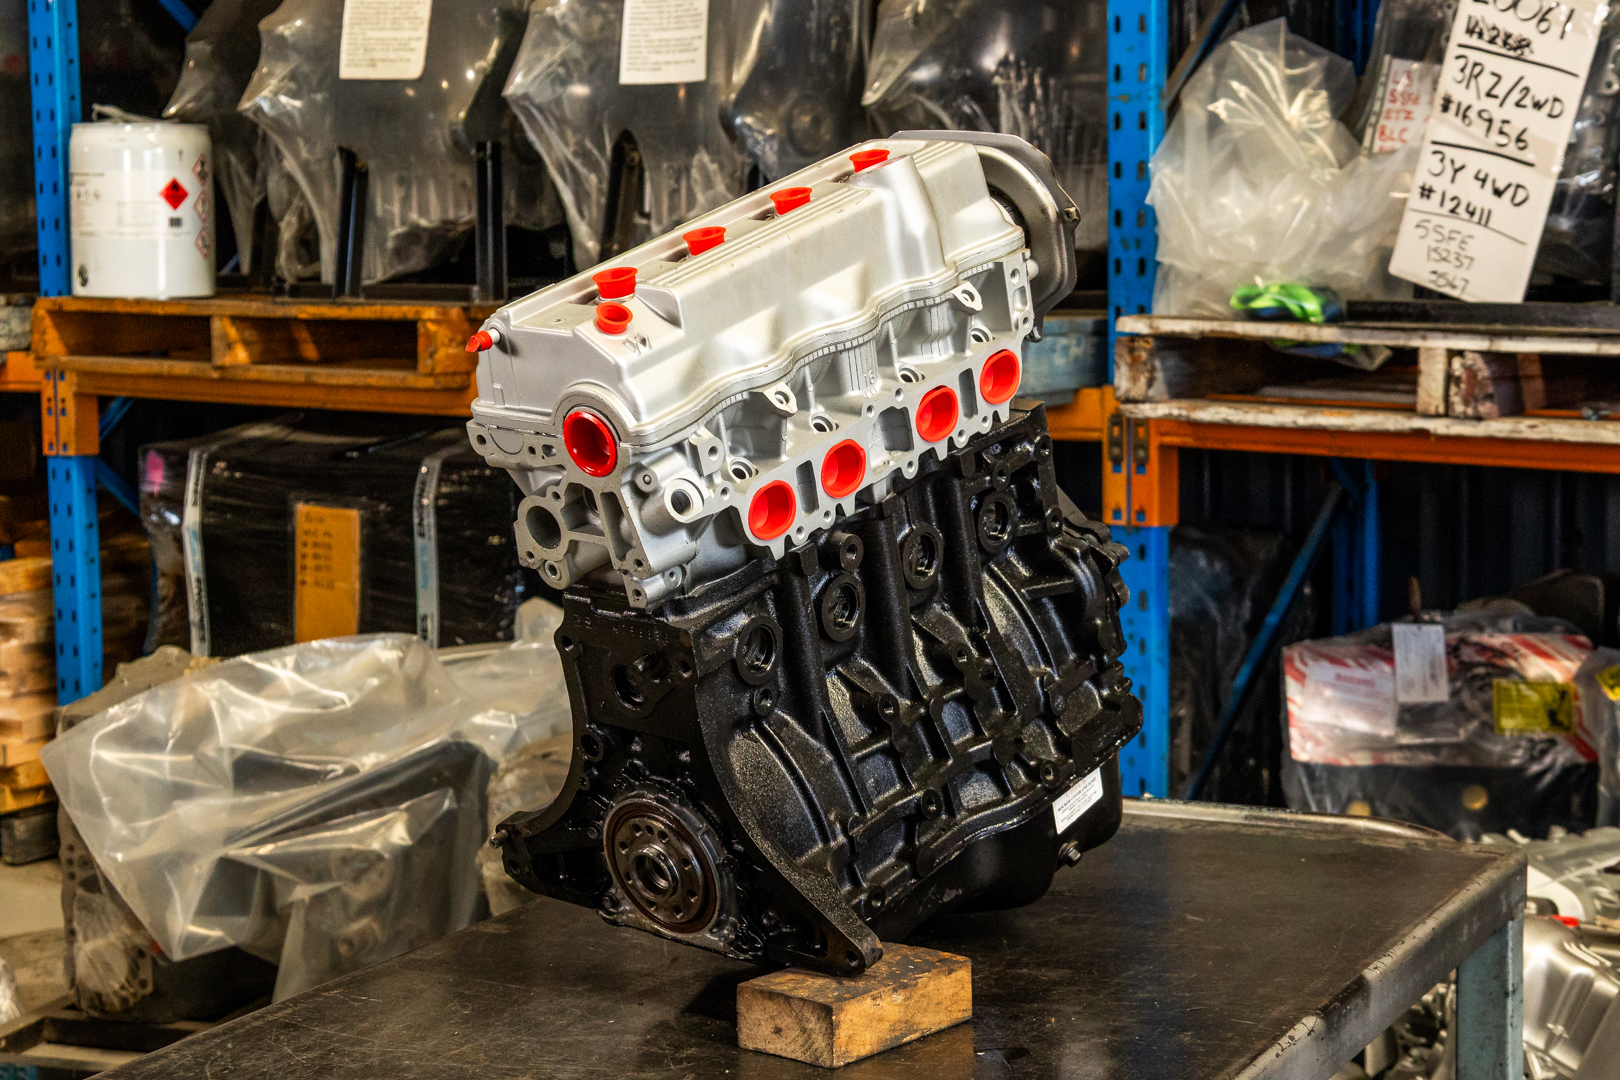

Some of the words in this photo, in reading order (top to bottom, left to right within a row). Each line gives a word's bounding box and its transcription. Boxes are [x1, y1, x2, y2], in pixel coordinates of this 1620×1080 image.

[1473, 0, 1575, 40] 061
[1440, 91, 1529, 150] #16956
[1419, 181, 1492, 227] #12411
[1427, 150, 1466, 184] 3Y
[1474, 167, 1530, 207] 4WD
